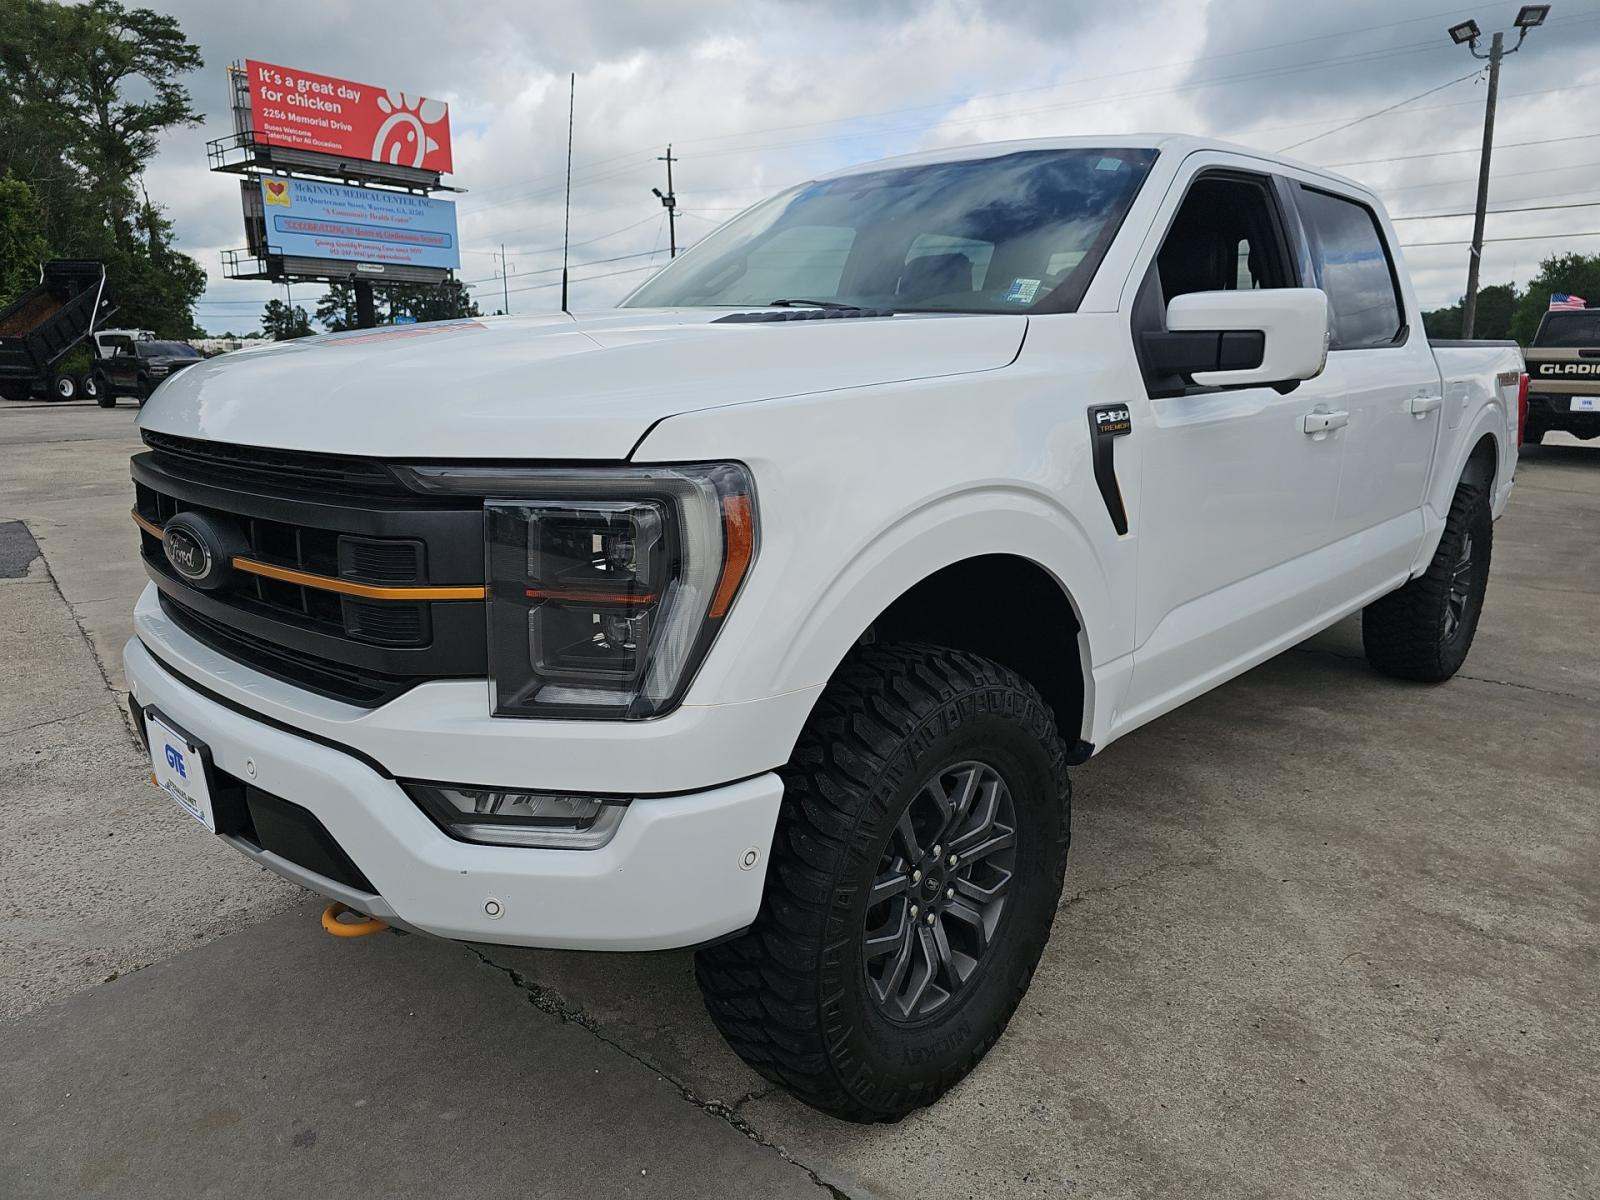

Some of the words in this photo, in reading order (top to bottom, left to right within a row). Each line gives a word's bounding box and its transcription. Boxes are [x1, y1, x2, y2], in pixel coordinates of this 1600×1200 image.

[259, 68, 282, 85] It's
[285, 76, 294, 87] a
[297, 79, 335, 96] great
[337, 85, 361, 104] day
[260, 86, 283, 102] for
[286, 93, 342, 114] chicken
[263, 108, 286, 120] 2256
[288, 112, 329, 127] Memorial
[331, 119, 353, 132] Drive
[283, 126, 312, 137] Welcome
[294, 182, 339, 196] McKINNEY
[341, 188, 380, 201] MEDICAL
[1539, 364, 1600, 374] GLADI
[1101, 422, 1130, 432] TREMOR
[169, 534, 196, 568] Ford
